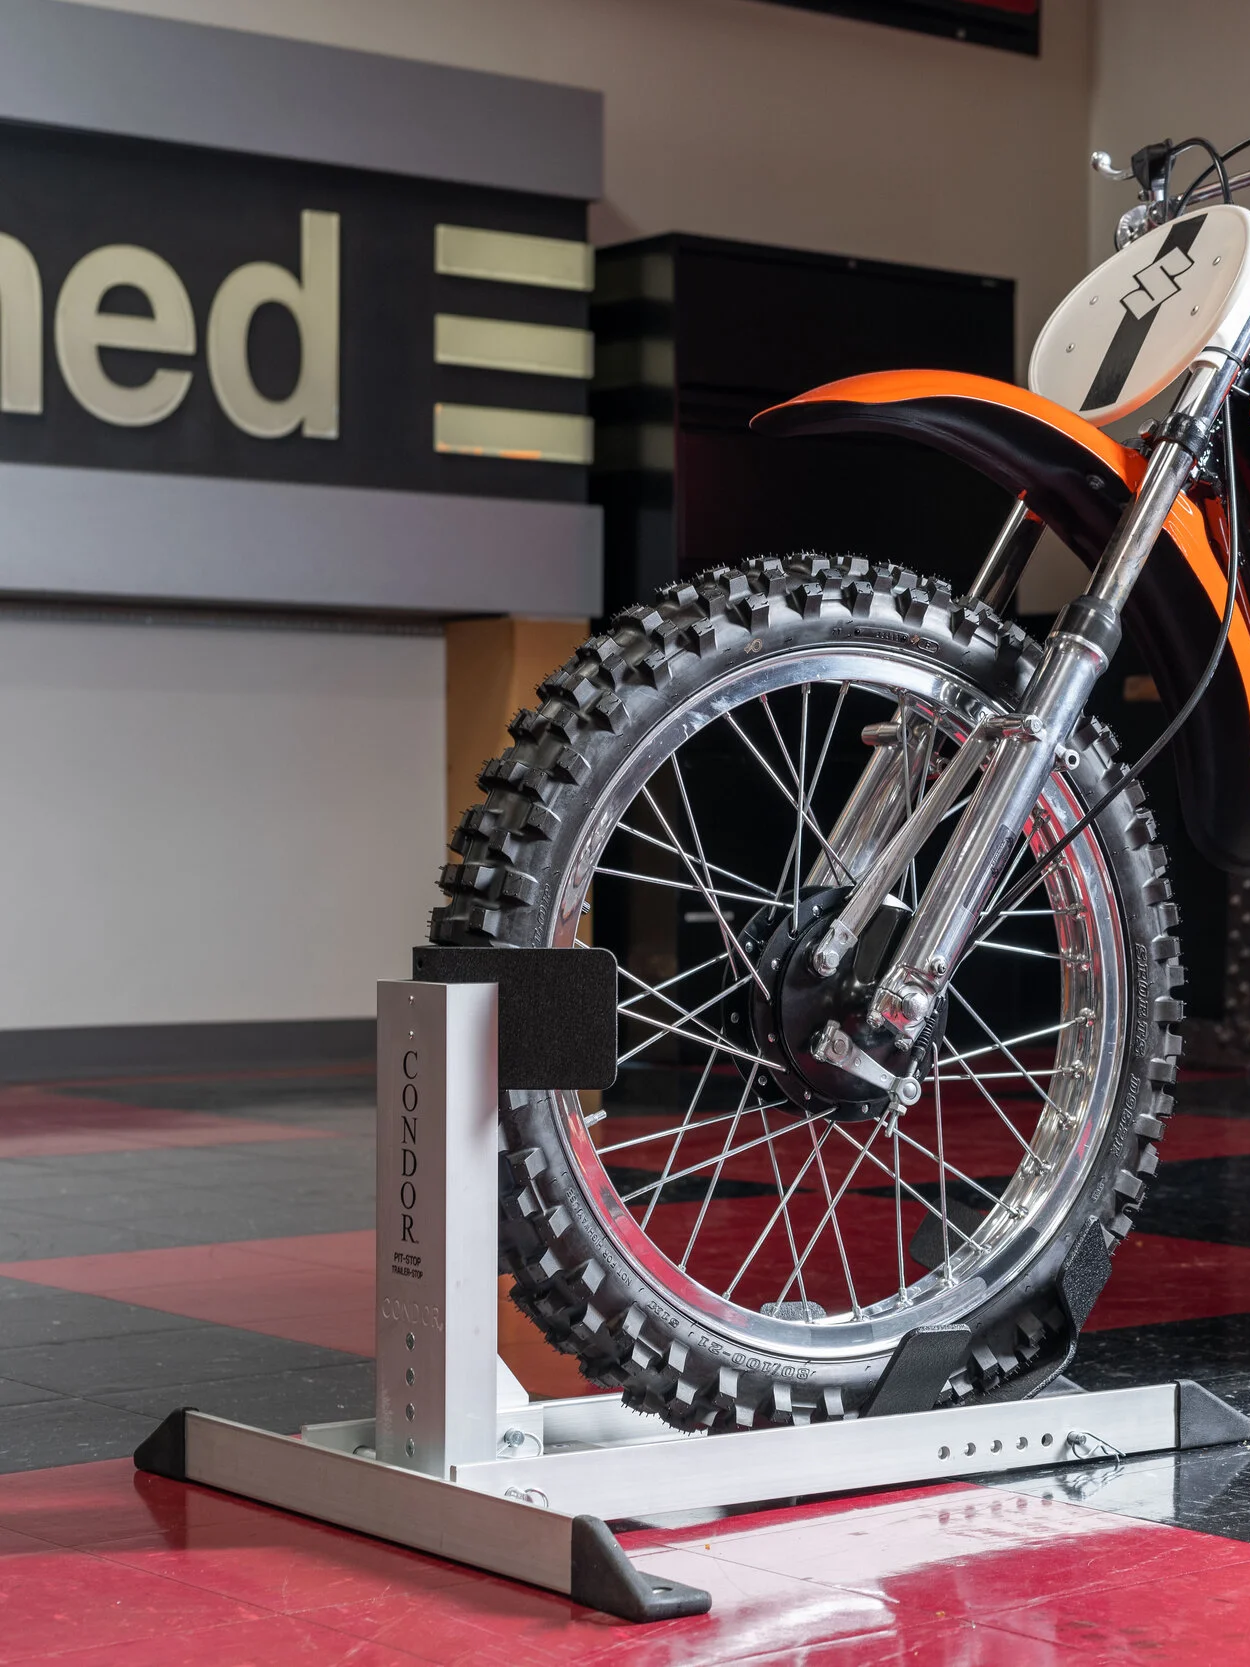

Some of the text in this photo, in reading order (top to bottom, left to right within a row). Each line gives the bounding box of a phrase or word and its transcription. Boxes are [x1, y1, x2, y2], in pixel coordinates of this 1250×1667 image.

[400, 1050, 419, 1244] CONDOR
[393, 1251, 422, 1267] PIT-STOP
[391, 1264, 424, 1280] TRAILER-STOP
